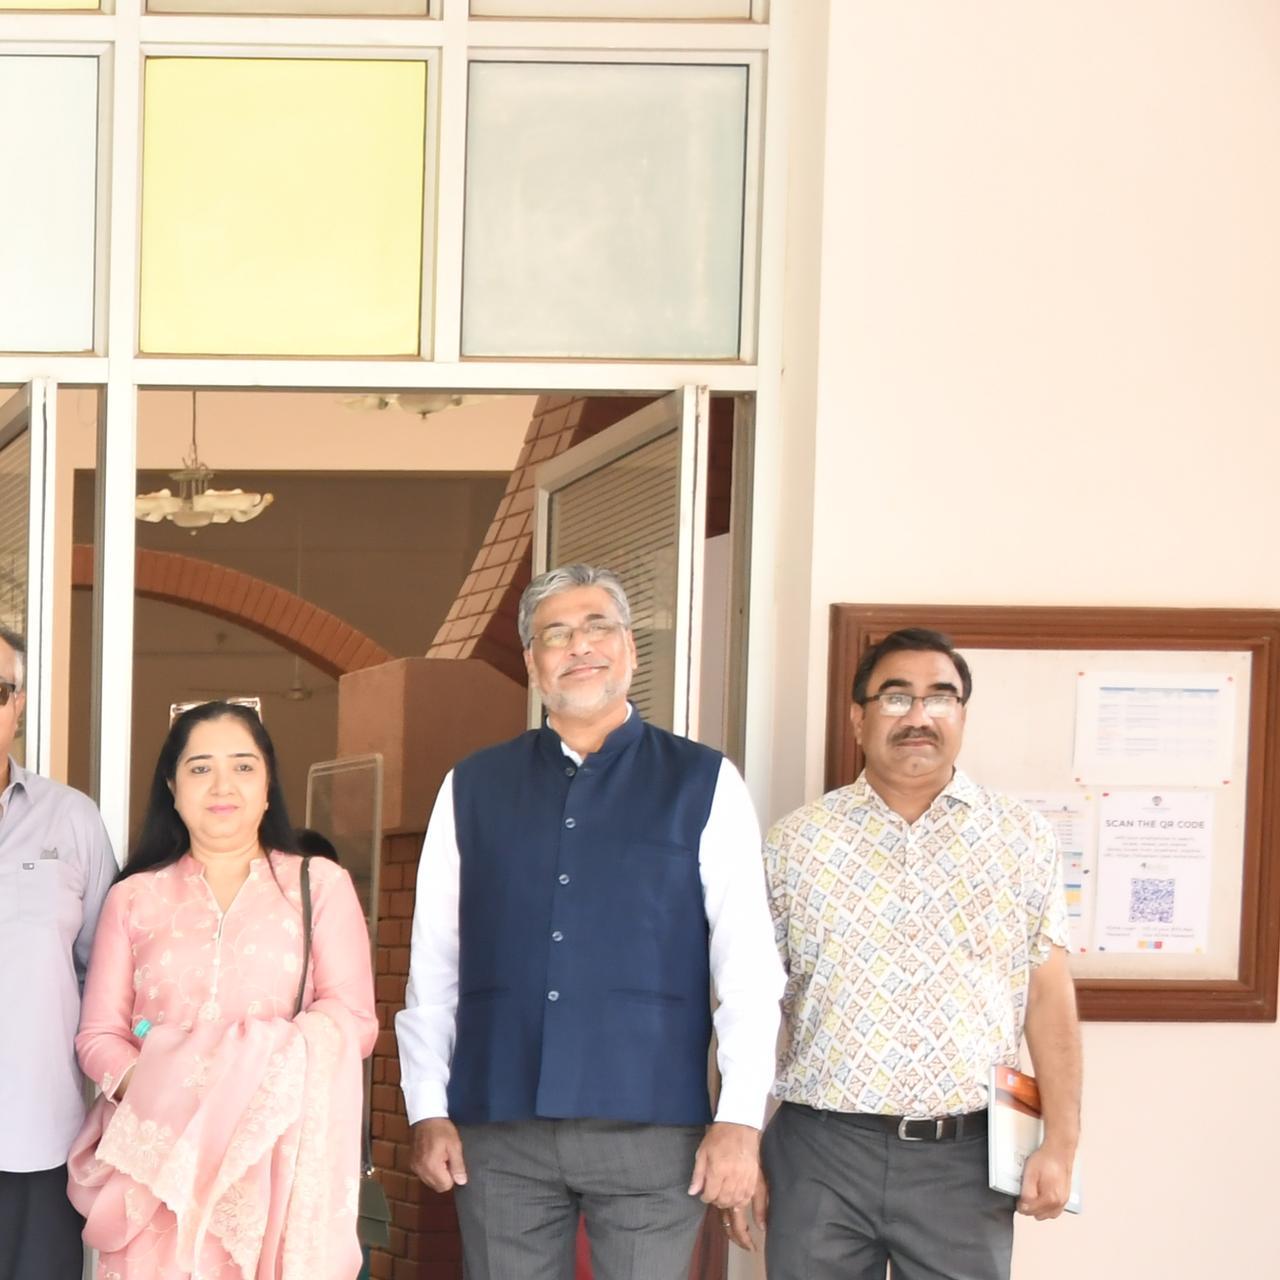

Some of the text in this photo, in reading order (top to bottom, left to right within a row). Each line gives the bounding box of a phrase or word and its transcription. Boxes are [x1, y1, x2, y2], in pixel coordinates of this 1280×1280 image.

[1105, 820, 1205, 829] SCAN THE QR CODE
